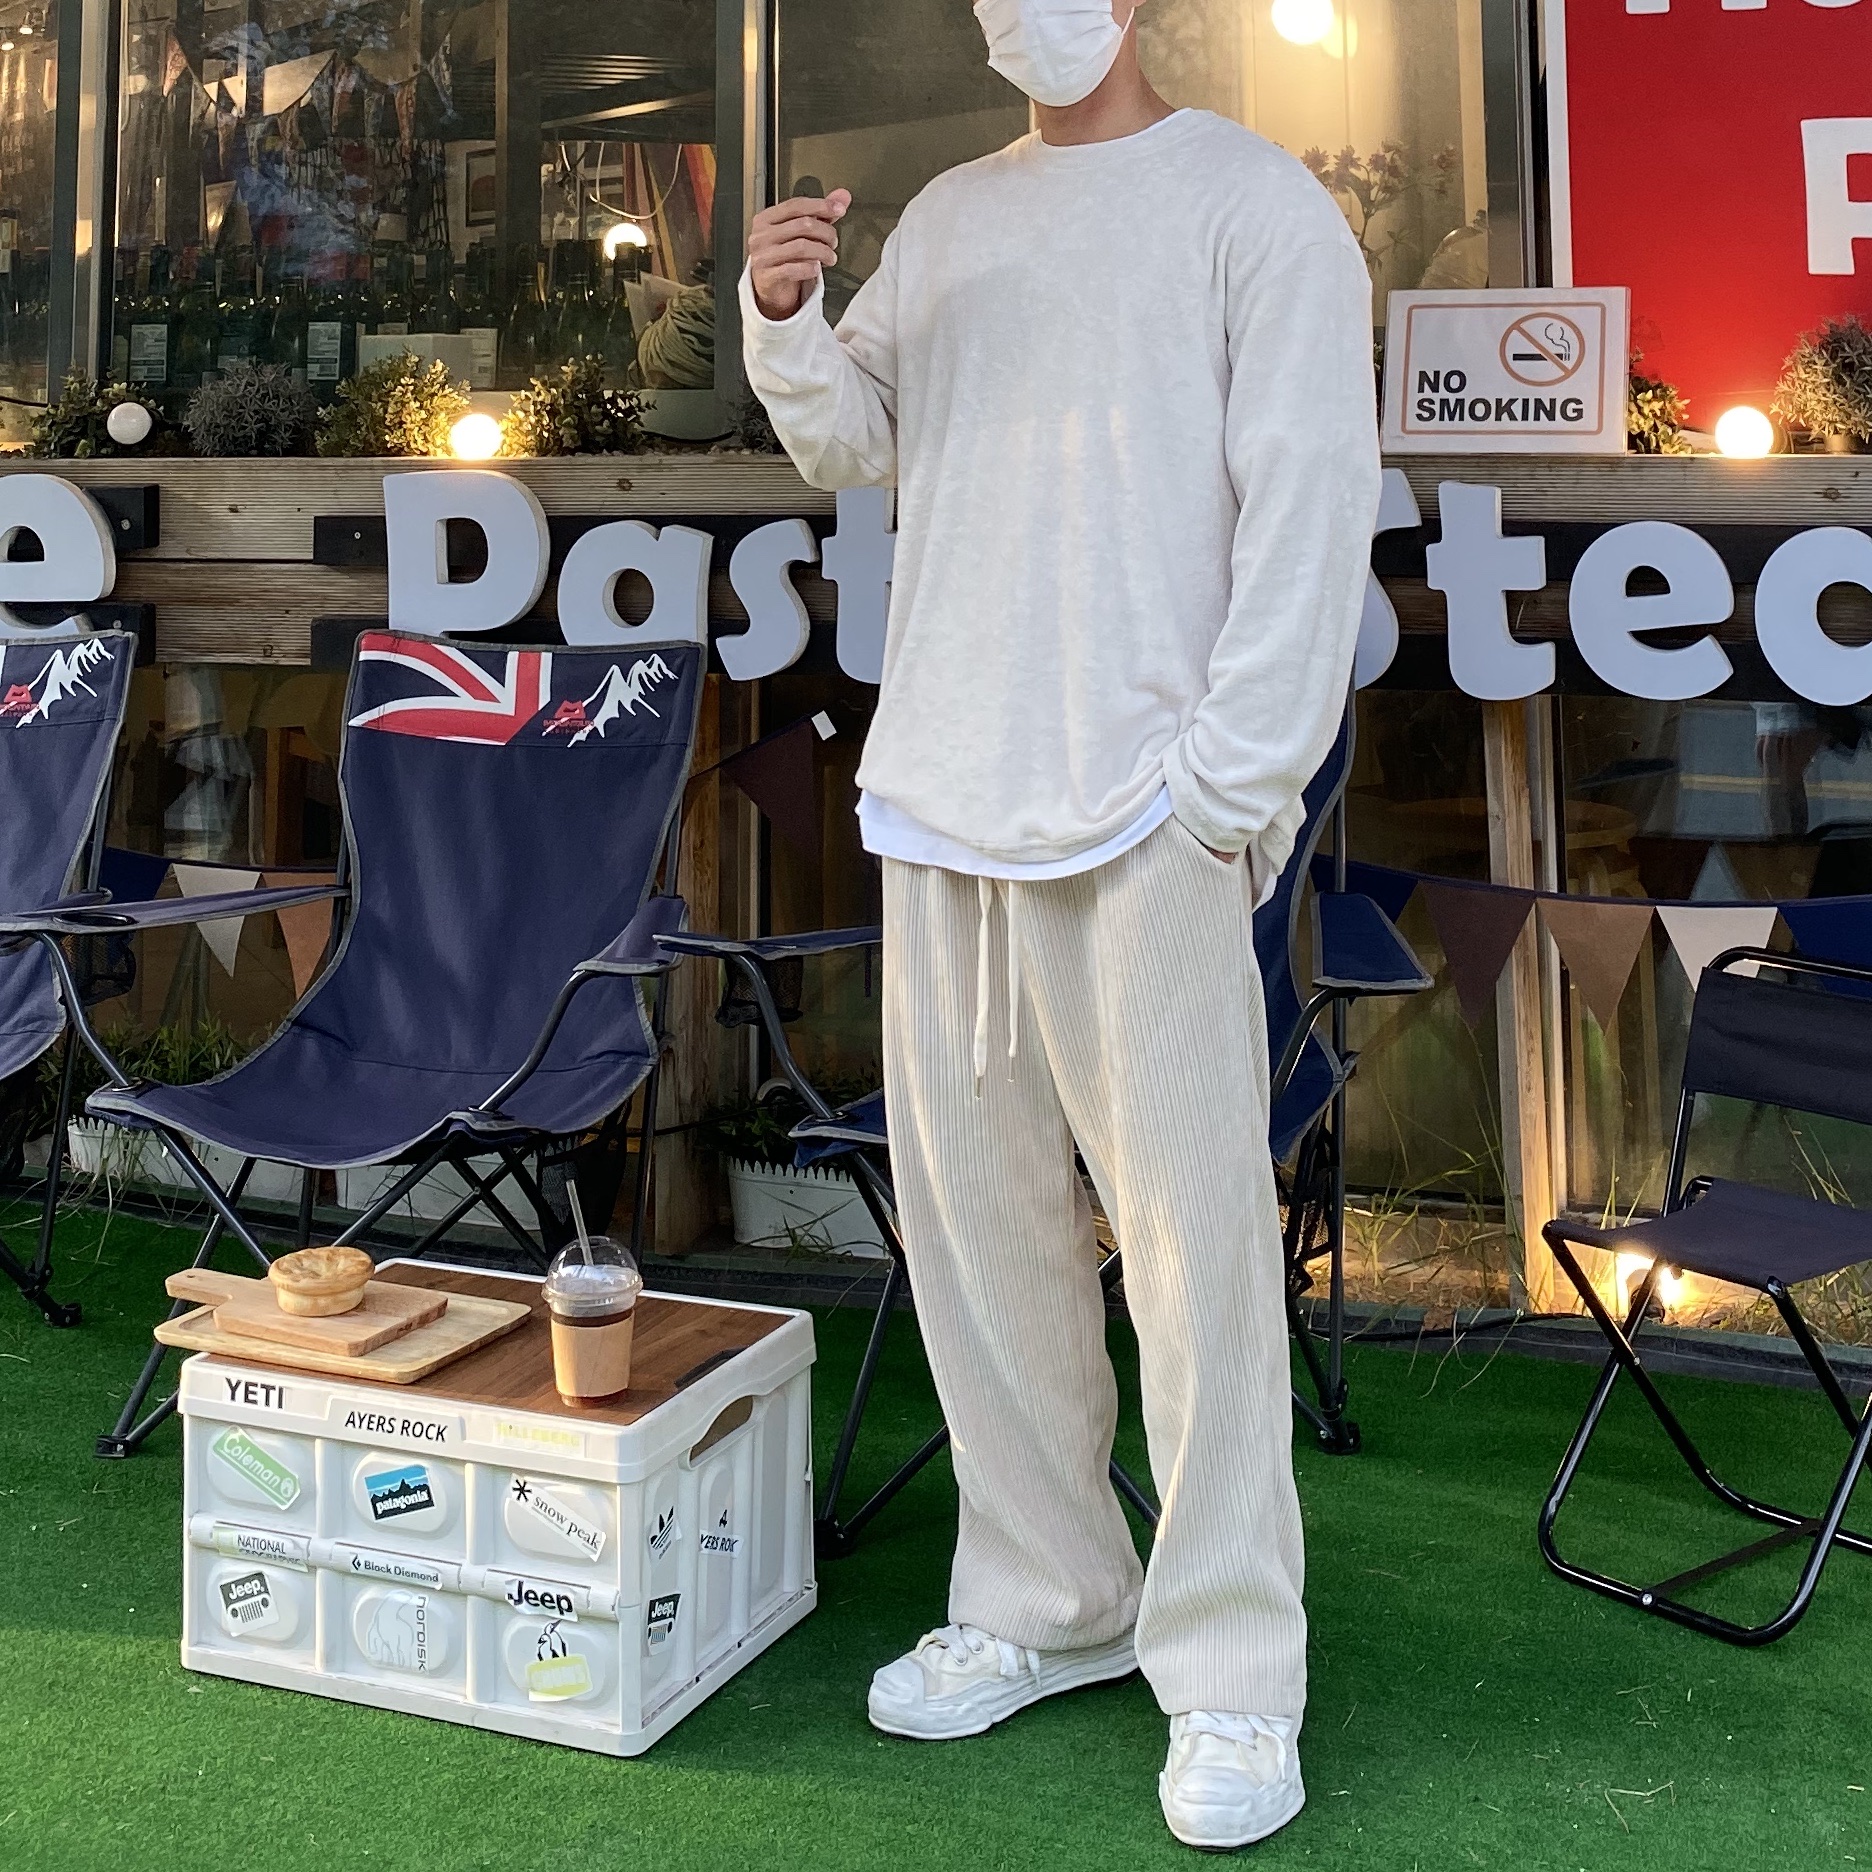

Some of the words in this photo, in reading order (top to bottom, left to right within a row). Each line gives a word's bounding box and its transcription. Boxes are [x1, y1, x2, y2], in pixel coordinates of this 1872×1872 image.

[1417, 370, 1467, 394] NO
[1415, 397, 1584, 422] SMOKING
[225, 1377, 286, 1409] YETI
[345, 1411, 396, 1434] AYERS
[400, 1418, 449, 1442] ROCK
[223, 1431, 281, 1489] Coleman
[375, 1489, 430, 1514] patagonia
[533, 1496, 569, 1526] snow
[566, 1521, 601, 1551] peak
[237, 1534, 287, 1555] NATIONAL
[364, 1560, 393, 1576] Black
[393, 1565, 440, 1583] Diamond
[507, 1580, 574, 1616] Jeep
